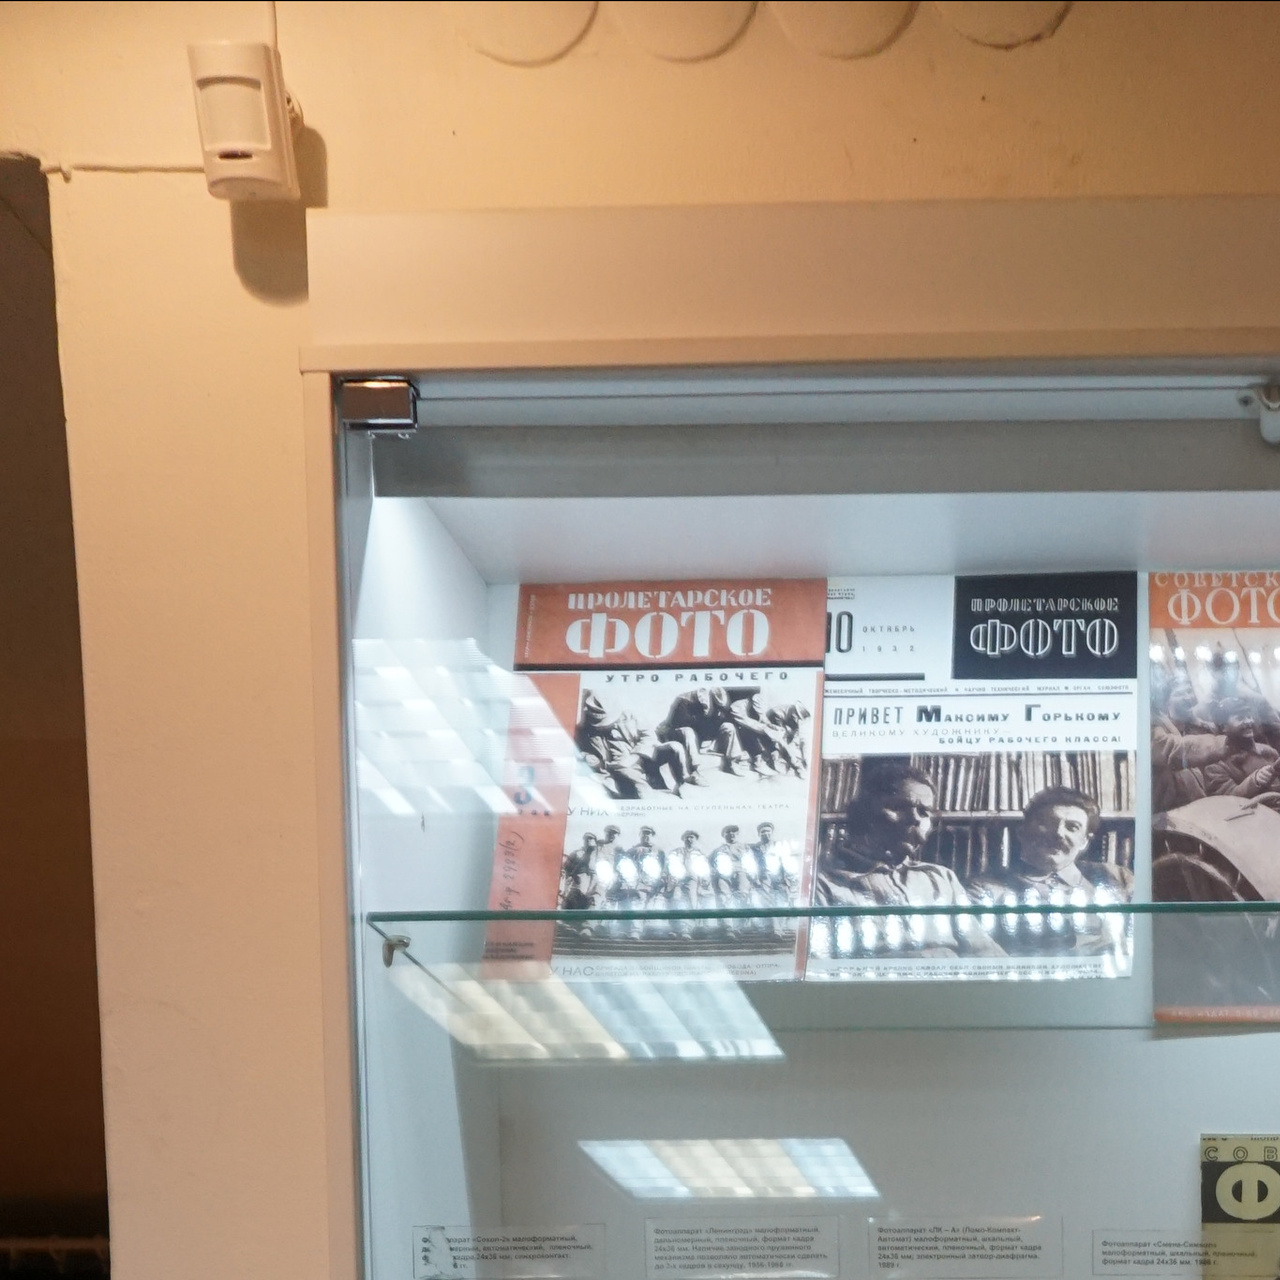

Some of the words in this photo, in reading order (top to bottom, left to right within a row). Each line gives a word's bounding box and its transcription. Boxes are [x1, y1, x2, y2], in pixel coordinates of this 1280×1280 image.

[568, 588, 771, 610] ПРОЛЕТАРСКОЕ
[971, 598, 1119, 612] ПРОЛЕТАРСКОЕ
[565, 609, 769, 658] ФОТО
[862, 625, 915, 634] ОКТЯБРЬ
[970, 619, 1120, 657] ФОТО
[605, 673, 659, 682] УТРО
[675, 671, 788, 682] РАБОЧЕГО
[833, 706, 904, 726] ПРИВЕТ
[916, 704, 1010, 724] МАКСИМУ
[1024, 703, 1121, 722] ГОРЬКОМУ
[832, 729, 905, 738] ВЕЛИКОМУ
[913, 727, 1000, 736] ХУДОЖНИКУ
[938, 735, 981, 745] БОЙЦУ
[988, 735, 1058, 745] РАБОЧЕГО
[1065, 734, 1121, 744] КЛАССА!
[562, 966, 594, 976] НАС
[877, 1226, 926, 1235] Фотоаппарат
[989, 1243, 1018, 1252] формат
[1101, 1240, 1151, 1249] Фотоаппарат
[1102, 1258, 1131, 1267] формат
